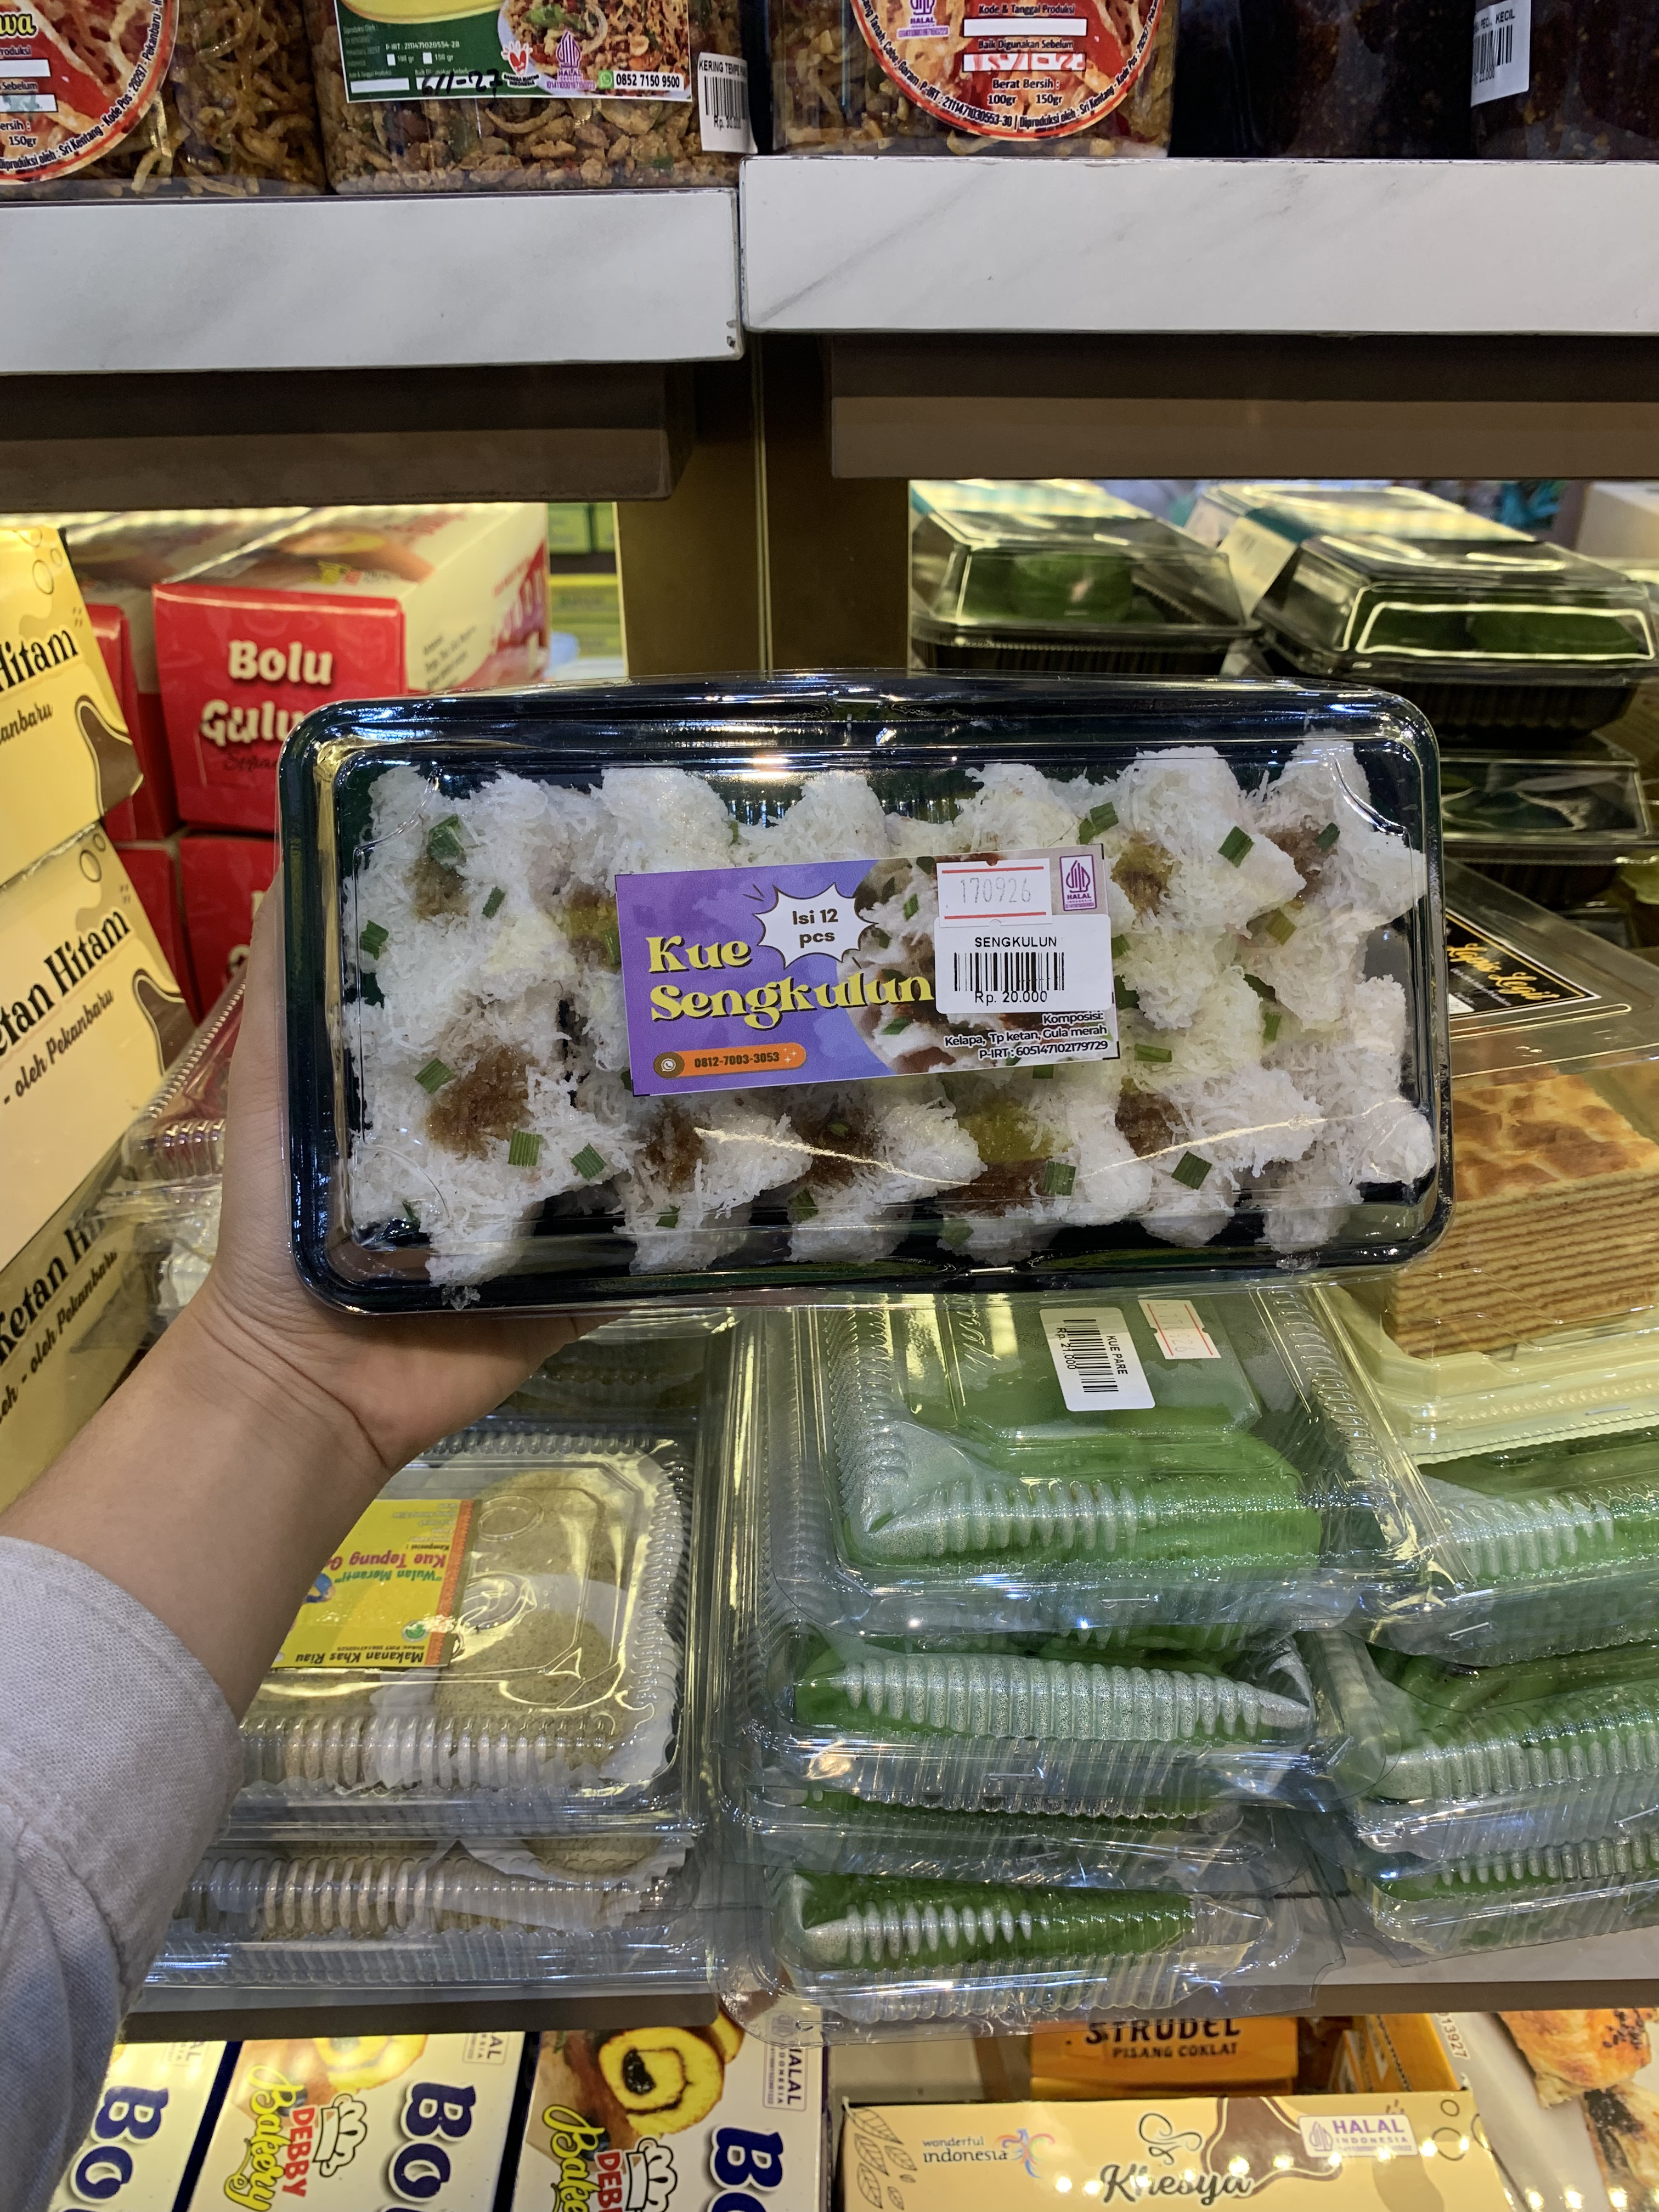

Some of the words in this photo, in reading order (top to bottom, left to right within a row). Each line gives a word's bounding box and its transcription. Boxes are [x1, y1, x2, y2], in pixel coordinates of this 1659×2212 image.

[979, 4, 1000, 13] Kode
[1002, 5, 1008, 13] &
[1011, 4, 1040, 15] Tanggal
[1042, 4, 1074, 13] Produksi
[1495, 9, 1516, 25] KECIL
[978, 40, 995, 49] Baik
[998, 40, 1040, 50] Digunakan
[1041, 40, 1074, 49] Sebelum
[699, 60, 724, 73] KERING
[59, 143, 72, 156] Sri
[72, 126, 104, 148] Kentang
[102, 105, 122, 126] Kode
[117, 94, 133, 110] Pos
[129, 64, 148, 93] 28297
[142, 13, 162, 61] Pekanbaru
[616, 74, 637, 86] 0852
[640, 75, 659, 87] 7150
[662, 76, 680, 88] 9500
[992, 79, 1020, 89] Berat
[1023, 78, 1053, 89] Bersih
[899, 61, 919, 87] Garam
[1019, 114, 1059, 128] Diproduksi
[1079, 103, 1090, 115] Sri
[1090, 86, 1115, 107] Kentang
[988, 94, 1017, 106] 100gr
[1036, 94, 1063, 106] 150gr
[9, 136, 37, 147] 150gr
[228, 640, 333, 686] Bolu
[960, 876, 1031, 904] 170926
[792, 910, 815, 925] Isi
[820, 909, 838, 923] 12
[799, 932, 836, 948] pcs
[974, 936, 1058, 947] SENGKULUN
[44, 910, 131, 997] Hitam
[645, 934, 753, 974] Kue
[650, 971, 934, 1031] Sengkulun
[974, 992, 997, 1006] Rp.
[1002, 991, 1048, 1003] 20.000
[1043, 1011, 1104, 1024] Komposisi:
[15, 1053, 48, 1098] oleh
[46, 988, 115, 1065] Pekanbaru
[944, 1036, 985, 1047] Kelapa,
[989, 1033, 1005, 1045] Tp
[1006, 1031, 1041, 1042] ketan,
[1042, 1028, 1068, 1039] Gula
[1070, 1025, 1107, 1036] merah
[694, 1052, 780, 1069] 0812-7003-3053
[979, 1048, 1008, 1059] P-IRT
[30, 1325, 57, 1375] oleh
[55, 1250, 119, 1335] Pekanbaru
[1055, 1327, 1067, 1340] Rp.
[1106, 1335, 1121, 1352] KUE
[1060, 1342, 1077, 1370] 21.000
[1112, 1353, 1128, 1375] PARE
[348, 1550, 407, 1569] Tepung
[414, 1553, 447, 1569] Kue
[294, 1652, 325, 1665] Riau
[329, 1651, 361, 1664] Khas
[365, 1651, 425, 1664] Makanan
[1085, 2017, 1241, 2044] STRUDEL
[1177, 2042, 1238, 2057] COKLAT
[1332, 2119, 1404, 2134] HALAL
[224, 2064, 304, 2212] Bakery
[922, 2135, 984, 2148] wonderful
[283, 2106, 318, 2197] DEBBY
[923, 2147, 1009, 2163] indonesia
[1101, 2163, 1251, 2206] Khesya
